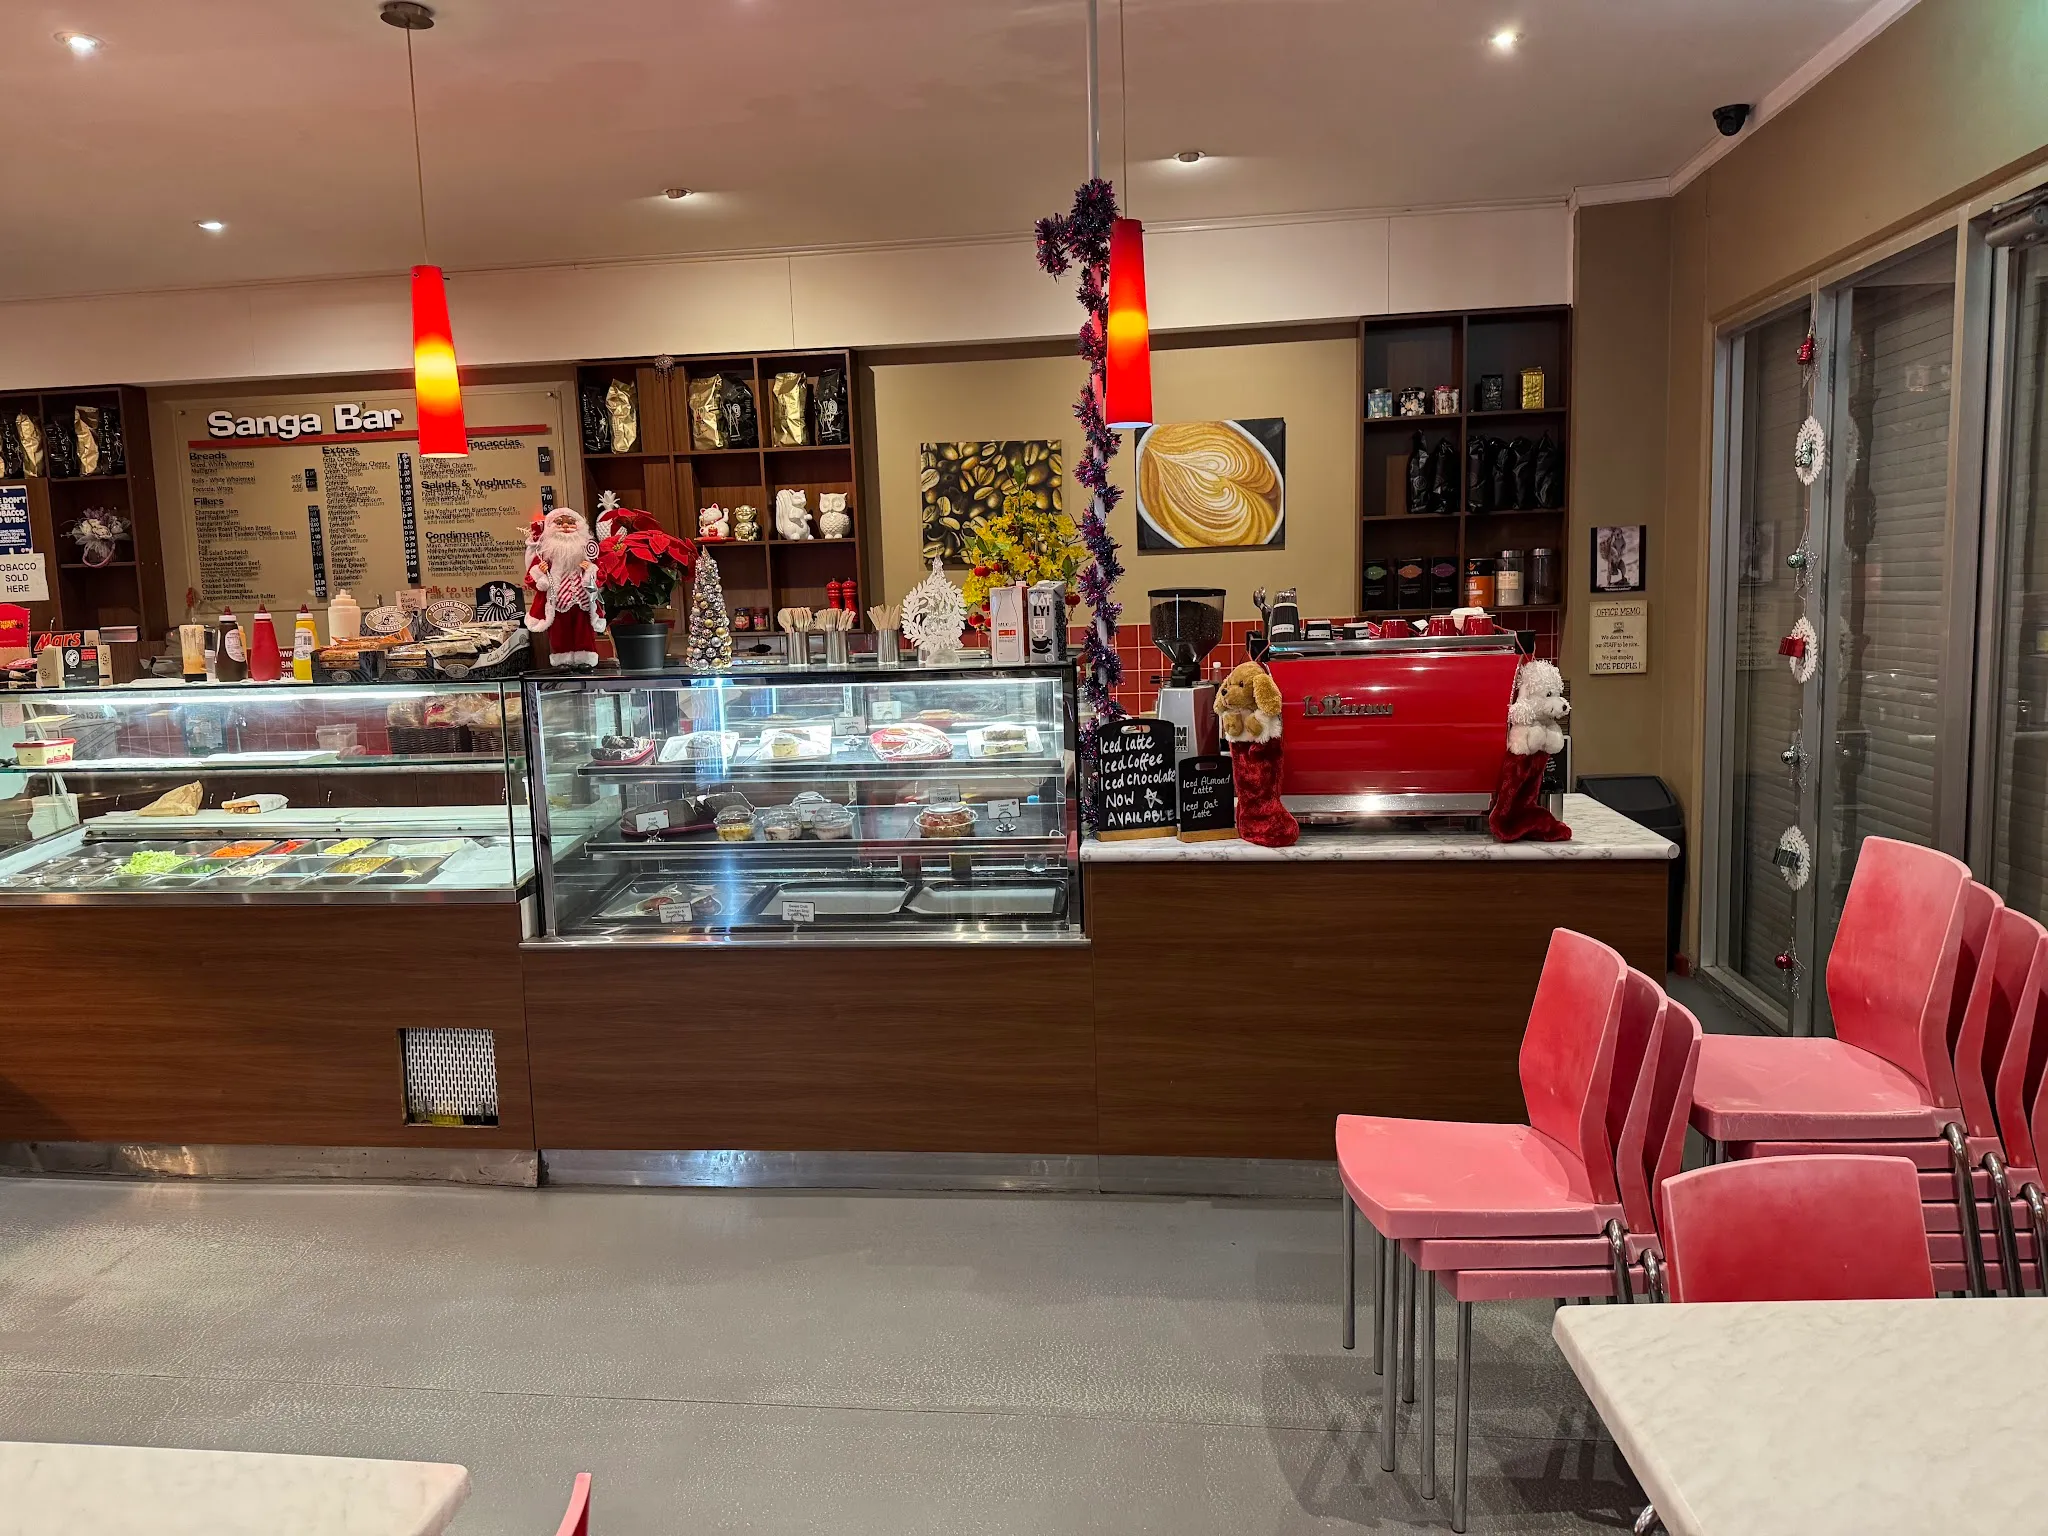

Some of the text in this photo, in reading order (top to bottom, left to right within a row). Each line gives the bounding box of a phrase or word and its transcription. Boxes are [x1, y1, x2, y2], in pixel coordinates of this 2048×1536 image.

[207, 403, 403, 441] Sanga Bar
[189, 451, 227, 460] Breads
[322, 446, 358, 455] Extras
[421, 480, 458, 489] Salads
[473, 478, 522, 489] Yoghurts
[3, 496, 26, 504] DON'T
[193, 497, 225, 507] Fillers
[425, 530, 491, 540] Condiments
[0, 563, 37, 572] OBACCO
[5, 573, 29, 582] SOLD
[6, 584, 30, 593] HERE
[446, 585, 457, 593] to
[429, 601, 454, 613] FUTURE
[1033, 605, 1050, 617] LY!
[1596, 606, 1641, 617] OFFICE MEMO
[33, 632, 82, 652] Mars
[1595, 662, 1611, 671] NICE
[1100, 735, 1122, 755] Iced
[1100, 758, 1125, 774] Iced
[1100, 776, 1125, 792] Iced
[1183, 777, 1198, 789] Iced
[1192, 785, 1214, 795] Latte
[1105, 790, 1135, 809] NOW
[1182, 798, 1219, 812] Iced Oat
[1107, 809, 1176, 827] AVAILABLE
